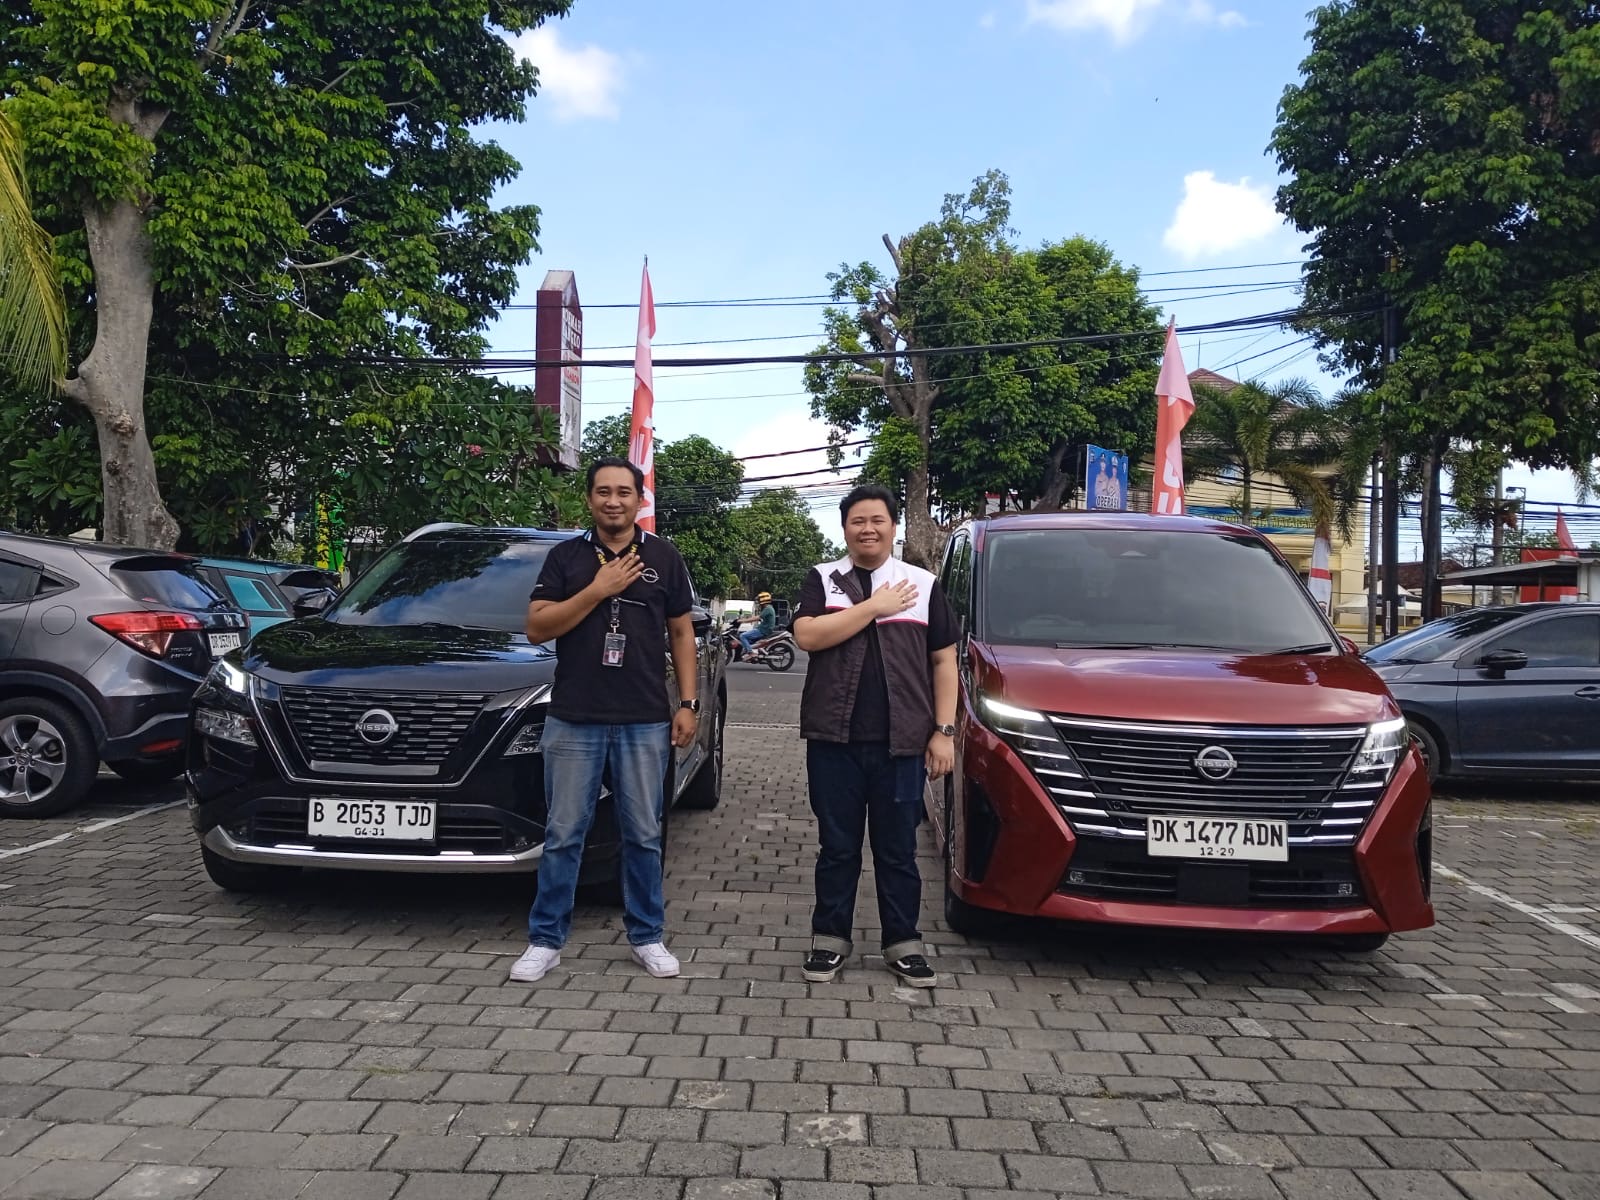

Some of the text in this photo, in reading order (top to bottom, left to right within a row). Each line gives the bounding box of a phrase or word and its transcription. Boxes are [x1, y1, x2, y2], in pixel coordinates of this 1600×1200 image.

[354, 722, 398, 732] NISSAN
[1194, 758, 1238, 768] NISSAN
[313, 801, 432, 827] B 2053 TJD
[1152, 819, 1284, 847] DK 1477 ADN
